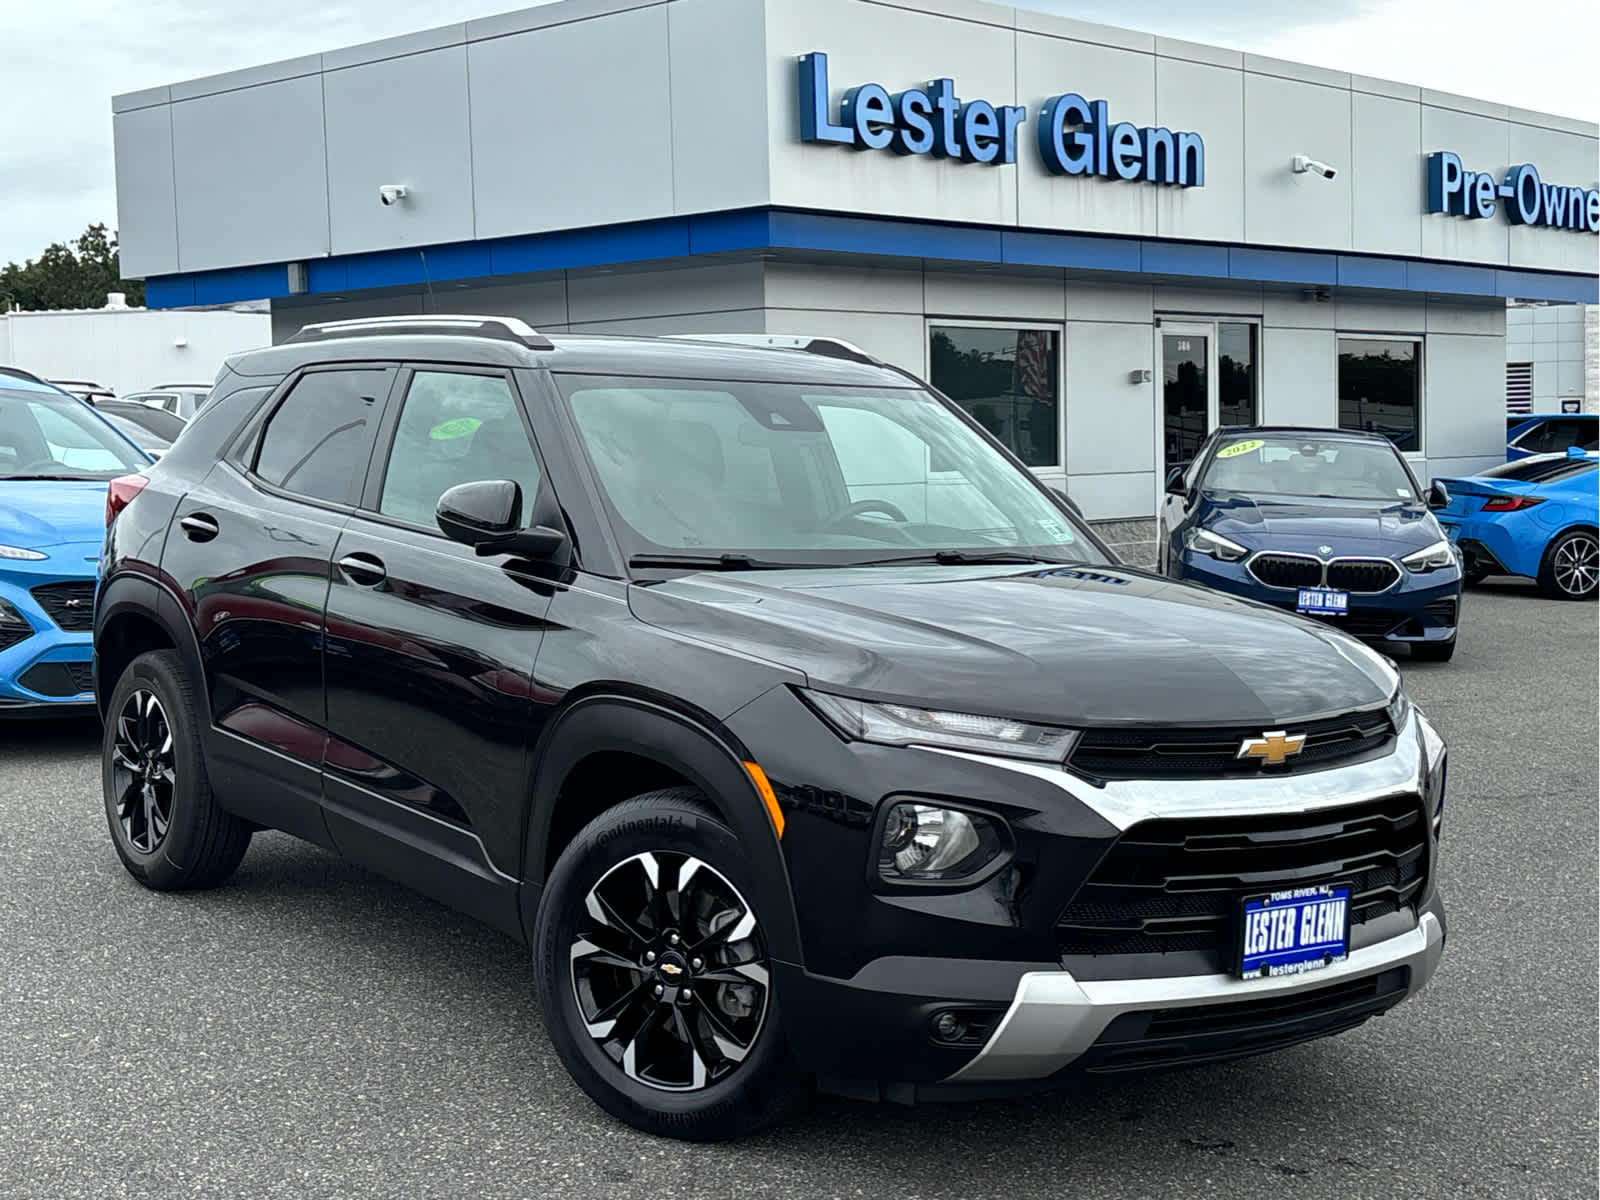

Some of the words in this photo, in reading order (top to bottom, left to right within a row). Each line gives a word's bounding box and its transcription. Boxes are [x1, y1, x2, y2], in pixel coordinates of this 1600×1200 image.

[799, 51, 1026, 165] Lester
[1039, 93, 1205, 187] Glenn
[1298, 590, 1323, 607] LESTER
[1325, 592, 1348, 608] GLENN
[597, 815, 673, 847] Continental
[1271, 890, 1292, 901] TOMS
[1244, 908, 1297, 955] LESTER
[1300, 901, 1346, 946] GLENN
